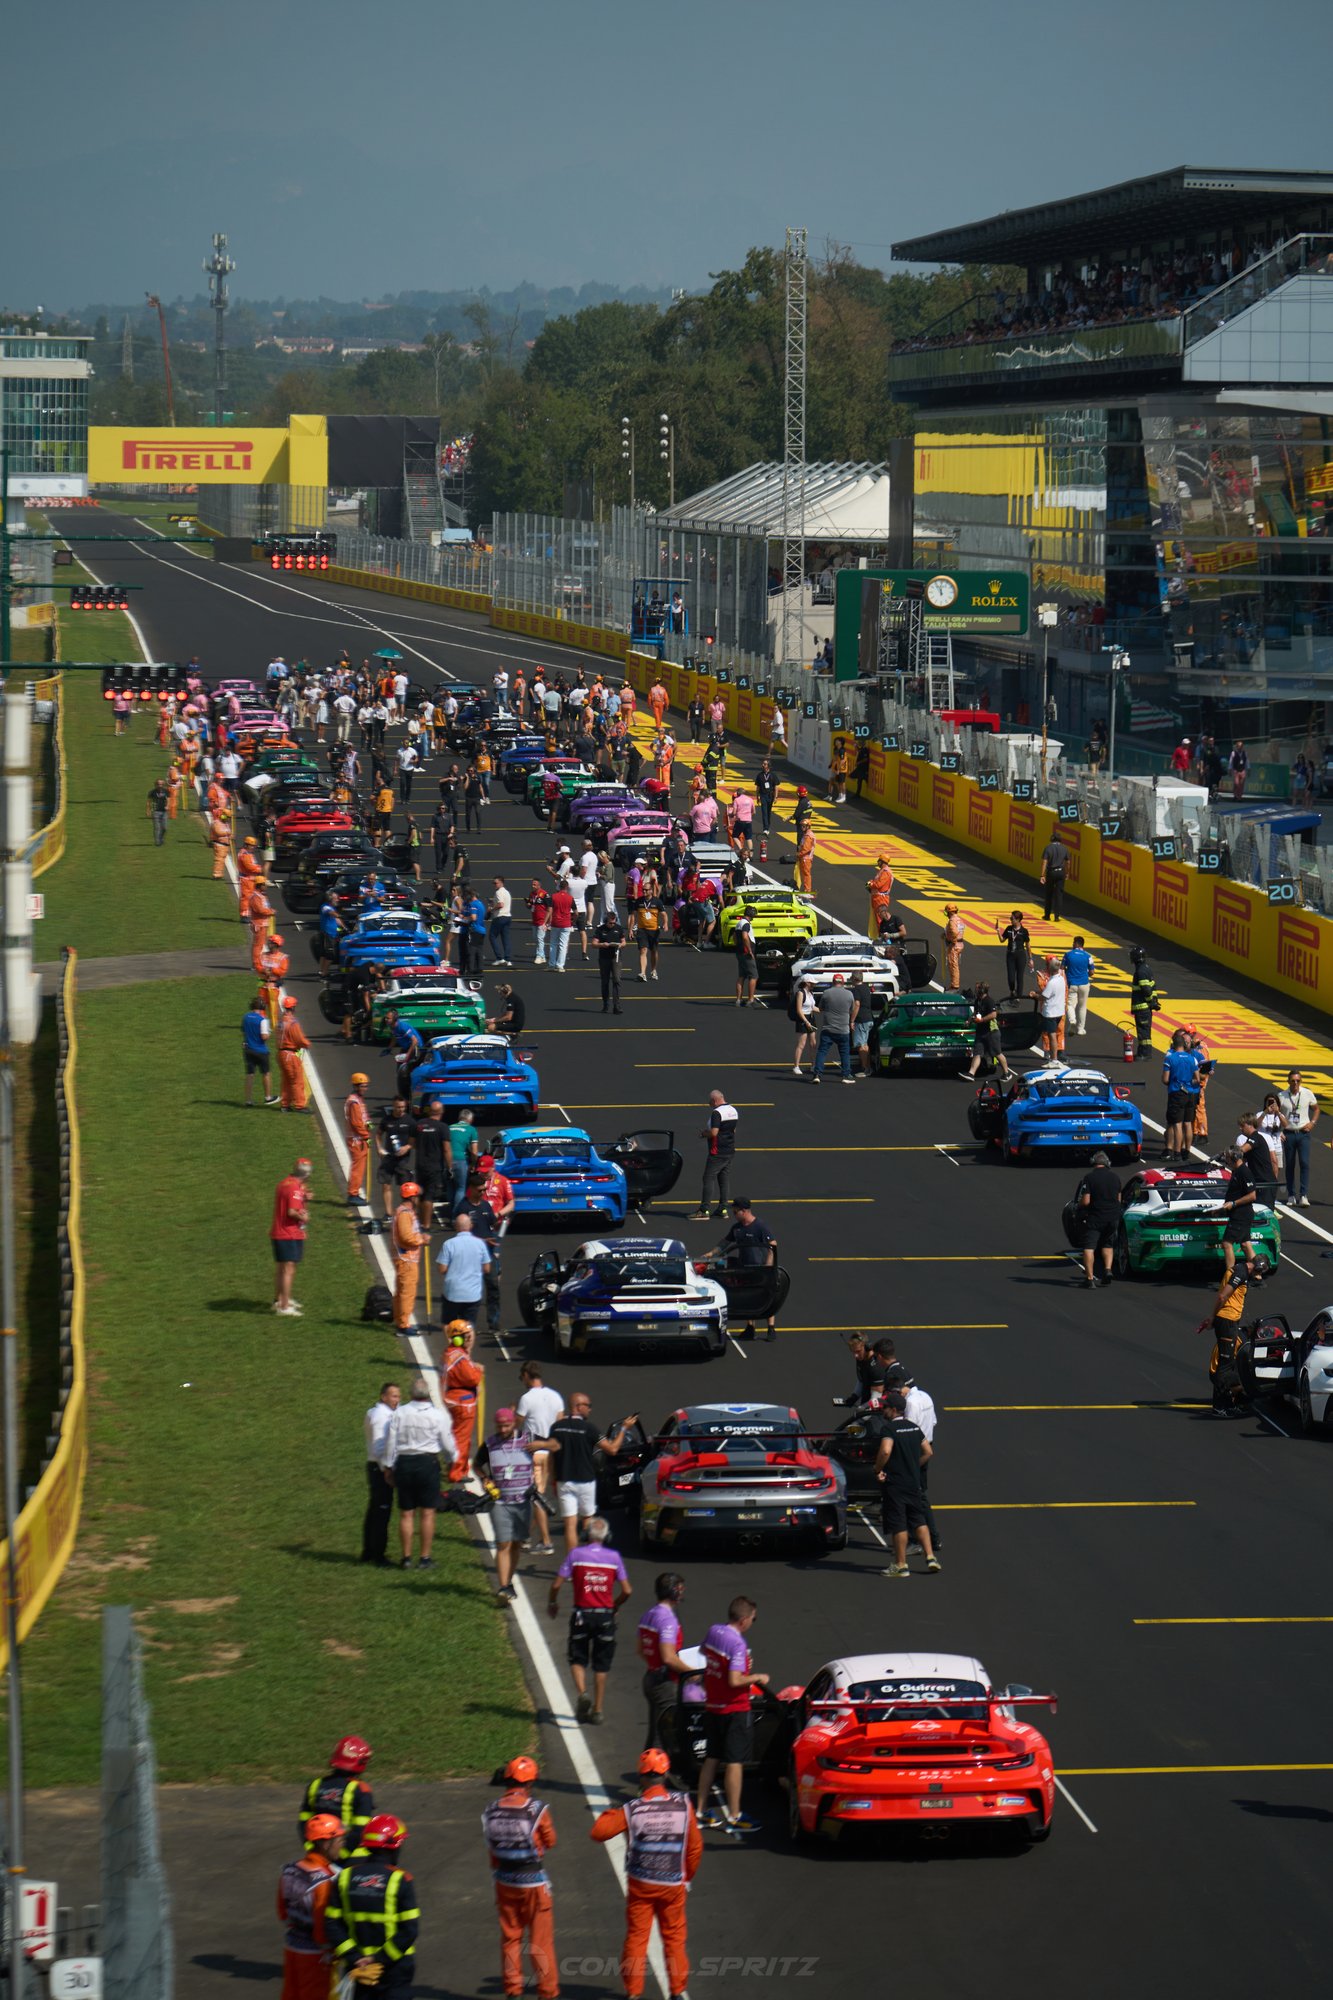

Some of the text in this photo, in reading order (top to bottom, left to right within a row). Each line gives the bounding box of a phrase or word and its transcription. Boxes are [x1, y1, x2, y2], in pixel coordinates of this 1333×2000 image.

[122, 440, 254, 470] PIRELLI
[971, 596, 1018, 607] ROLEX
[686, 659, 693, 669] 1
[700, 663, 707, 673] 2
[720, 671, 727, 681] 3
[739, 677, 747, 687] 4
[757, 684, 765, 695] 5
[785, 696, 793, 706] 7
[806, 705, 814, 715] 8
[833, 718, 842, 728] 9
[855, 726, 870, 737] 10
[883, 736, 897, 748] 11
[911, 744, 926, 757] 12
[941, 756, 957, 769] 13
[897, 759, 919, 811] PIRELLI
[979, 774, 998, 788] 14
[1014, 784, 1031, 797] 15
[931, 773, 955, 828] PIRELLI
[967, 788, 993, 845] PIRELLI
[1059, 804, 1078, 819] 16
[1007, 804, 1036, 863] PIRELLI
[1102, 821, 1121, 836] 17
[1153, 841, 1175, 856] 18
[1200, 854, 1219, 869] 19
[1099, 841, 1132, 898] PIRELLI
[1152, 861, 1189, 932] PIRELLI
[1269, 884, 1294, 900] 20
[1212, 883, 1252, 961] PIRELLI
[1277, 911, 1320, 991] PIRELLI
[624, 1251, 668, 1259] Lindland
[880, 1683, 956, 1693] G. Guirreri
